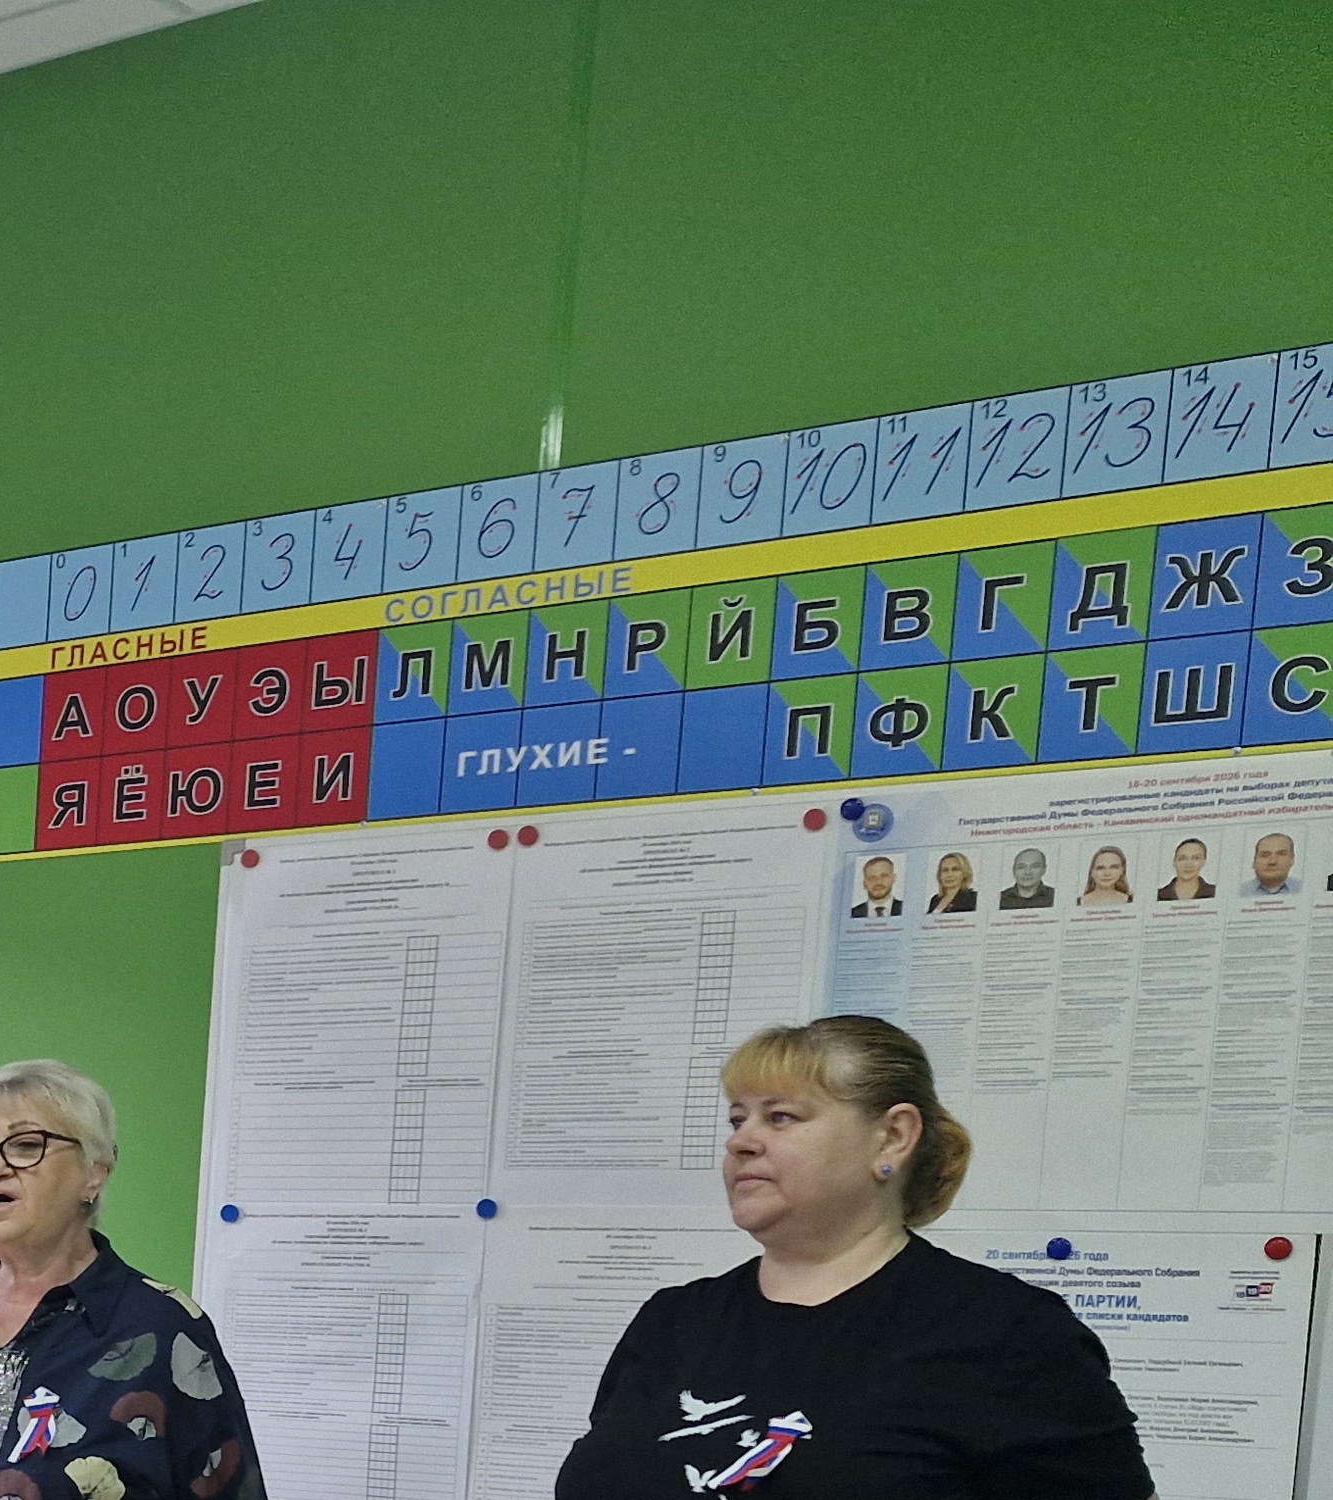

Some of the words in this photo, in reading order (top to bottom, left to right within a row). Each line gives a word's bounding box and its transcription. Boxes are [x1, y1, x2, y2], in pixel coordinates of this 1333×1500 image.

[56, 554, 66, 568] 0
[122, 544, 127, 557] 1
[185, 533, 194, 547] 2
[253, 521, 263, 536] 3
[322, 509, 333, 524] 4
[397, 498, 407, 513] 5
[472, 486, 482, 501] 6
[550, 473, 561, 488] 7
[631, 460, 641, 475] 8
[714, 447, 726, 462] 9
[797, 430, 821, 448] 10
[887, 416, 907, 433] 11
[982, 400, 1007, 419] 12
[1080, 384, 1106, 401] 13
[1183, 367, 1209, 385] 14
[1290, 350, 1318, 369] 15
[64, 566, 96, 621] 0
[132, 555, 156, 611] 1
[194, 545, 226, 601] 2
[261, 533, 294, 591] 3
[334, 524, 363, 580] 4
[399, 511, 433, 571] 5
[478, 498, 517, 558] 6
[562, 485, 595, 546] 7
[638, 473, 680, 535] 8
[720, 460, 762, 523] 9
[791, 443, 866, 515] 10
[882, 433, 962, 501] 11
[976, 414, 1055, 488] 12
[1073, 398, 1155, 474] 13
[1176, 382, 1255, 458] 14
[386, 568, 633, 623] СОГЛАСНЫЕ
[51, 694, 93, 742] А
[115, 685, 157, 731] О
[184, 675, 223, 725] У
[249, 668, 290, 717] Э
[312, 656, 369, 711] Ы
[390, 648, 435, 700] Л
[463, 639, 514, 692] М
[544, 629, 587, 682] Н
[624, 620, 668, 674] Р
[707, 595, 755, 665] Й
[792, 597, 840, 654] Б
[881, 587, 932, 645] В
[979, 574, 1027, 632] Г
[1067, 560, 1131, 634] Д
[1161, 546, 1248, 613] Ж
[1283, 535, 1333, 597] З
[51, 627, 207, 669] ГЛАСНЫЕ
[48, 781, 88, 829] Я
[113, 765, 147, 823] Ё
[167, 767, 223, 818] Ю
[244, 760, 282, 810] Е
[312, 753, 354, 804] И
[456, 738, 610, 778] ГЛУХИЕ
[784, 704, 833, 759] П
[868, 696, 930, 749] Ф
[968, 685, 1019, 743] К
[1066, 674, 1119, 733] Т
[1152, 663, 1235, 725] Ш
[1270, 654, 1332, 715] С
[1058, 1267, 1083, 1277] Думы
[1086, 1267, 1153, 1278] Федерального
[1155, 1268, 1201, 1278] Собрания
[1084, 1252, 1109, 1262] года
[1061, 1279, 1104, 1289] девятого
[1106, 1280, 1141, 1288] созыва
[1075, 1294, 1141, 1310] ПАРТИИ,
[1086, 1313, 1123, 1322] списки
[1126, 1312, 1189, 1323] кандидатов
